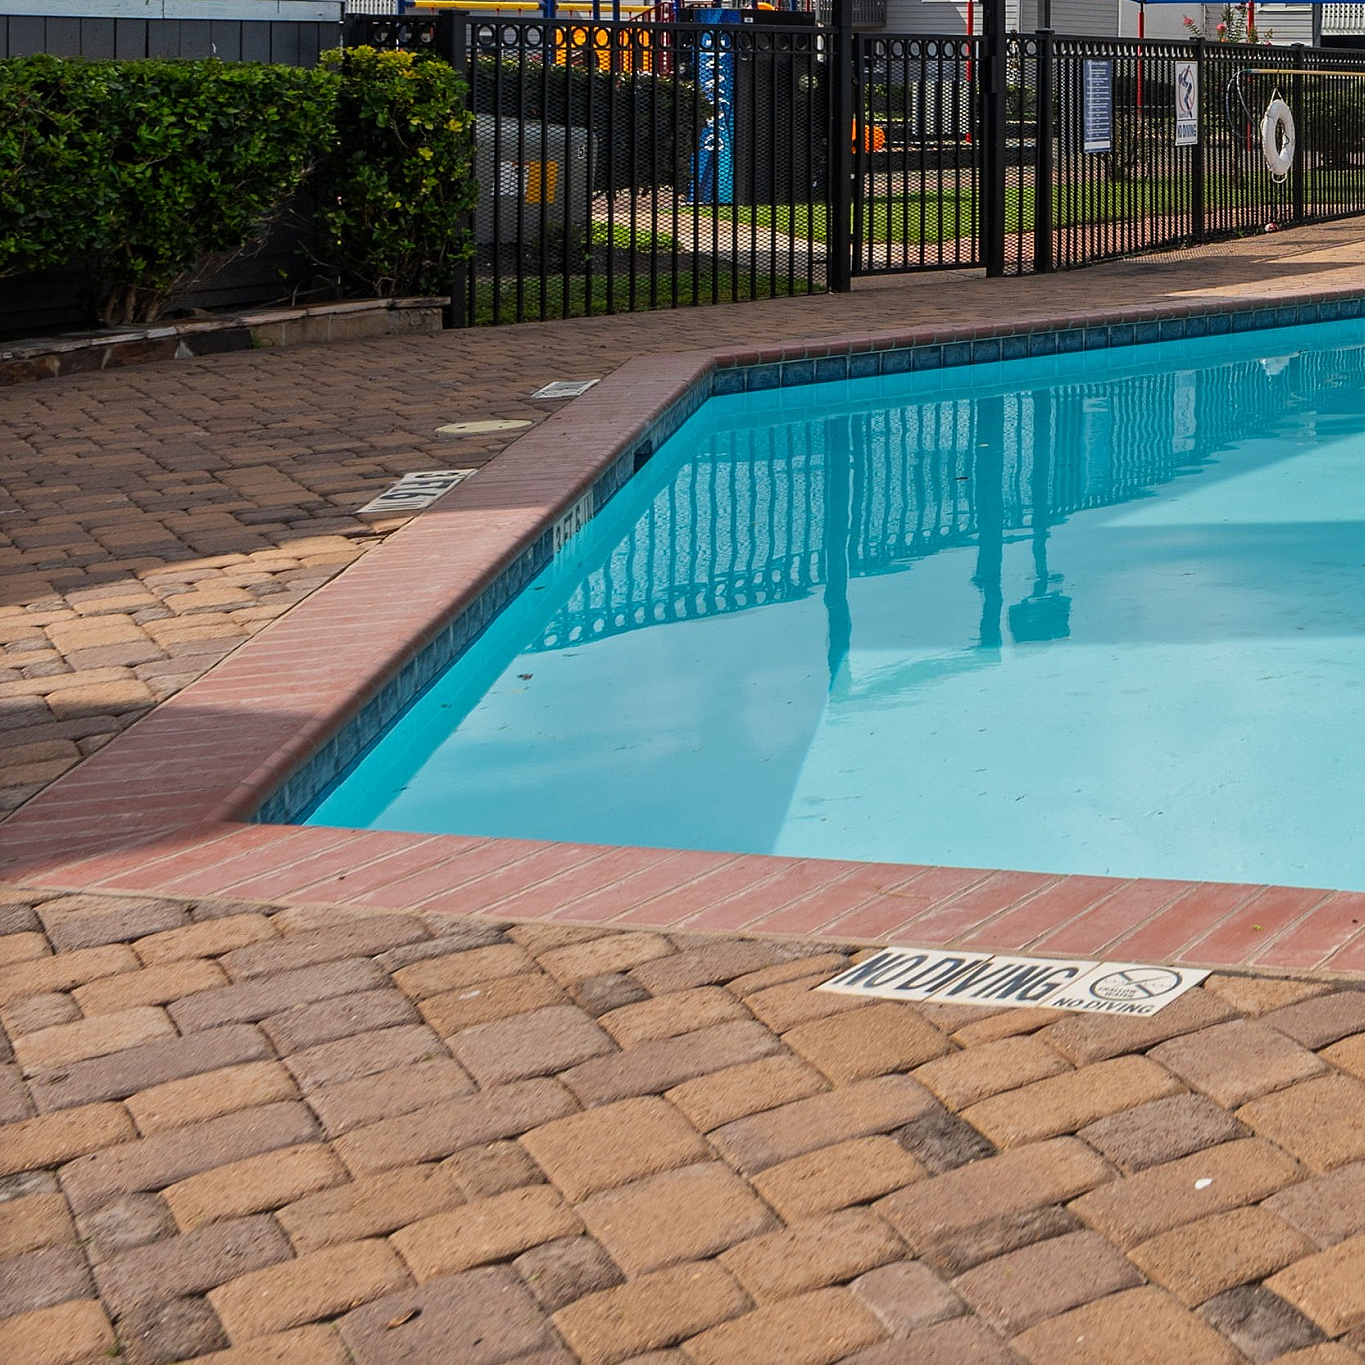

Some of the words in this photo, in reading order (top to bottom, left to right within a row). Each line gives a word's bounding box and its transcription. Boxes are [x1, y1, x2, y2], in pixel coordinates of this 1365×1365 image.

[834, 953, 919, 988] NO
[895, 957, 1079, 1001] DIVING
[1053, 997, 1084, 1007] NO
[1084, 999, 1155, 1013] DIVING
